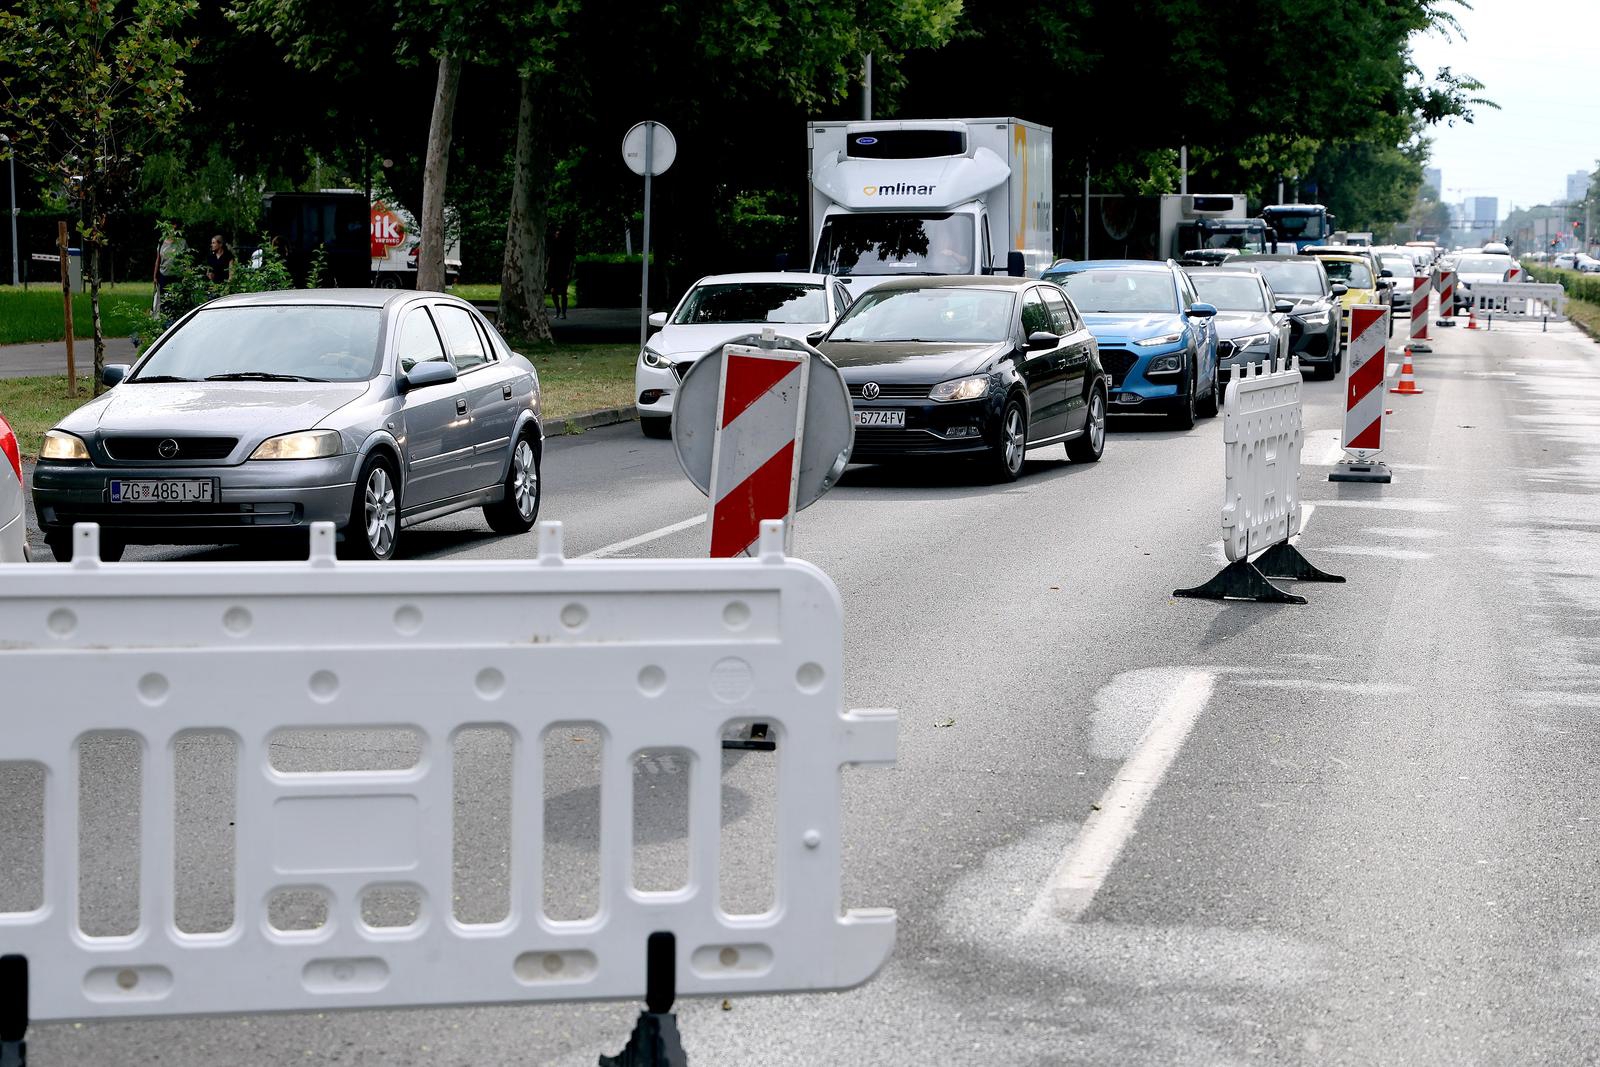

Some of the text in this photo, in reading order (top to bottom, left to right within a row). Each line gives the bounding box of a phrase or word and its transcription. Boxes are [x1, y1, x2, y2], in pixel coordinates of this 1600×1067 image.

[879, 182, 936, 195] mlinar
[371, 215, 400, 238] ik
[121, 483, 140, 500] ZG
